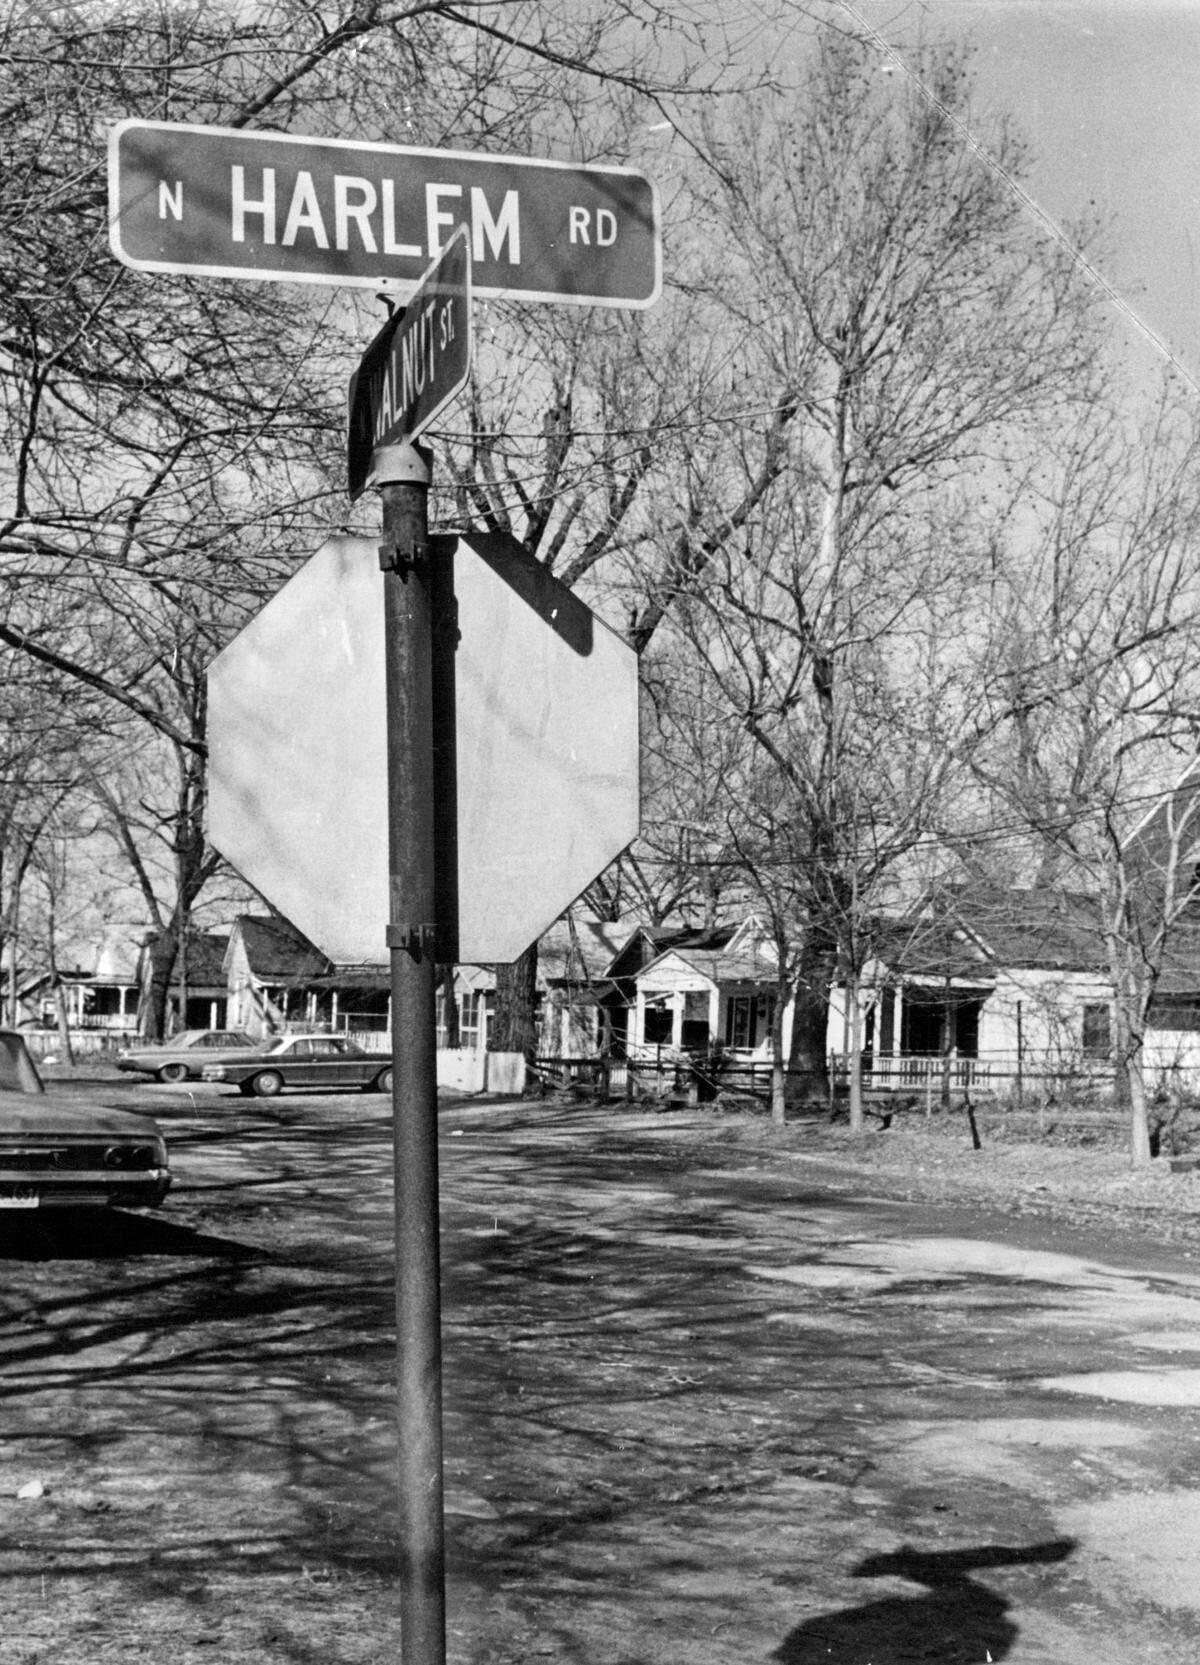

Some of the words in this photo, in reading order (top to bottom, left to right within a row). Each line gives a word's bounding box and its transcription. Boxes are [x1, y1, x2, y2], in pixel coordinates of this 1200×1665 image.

[158, 180, 183, 220] N
[230, 165, 521, 264] HARLEM
[568, 205, 618, 246] RD
